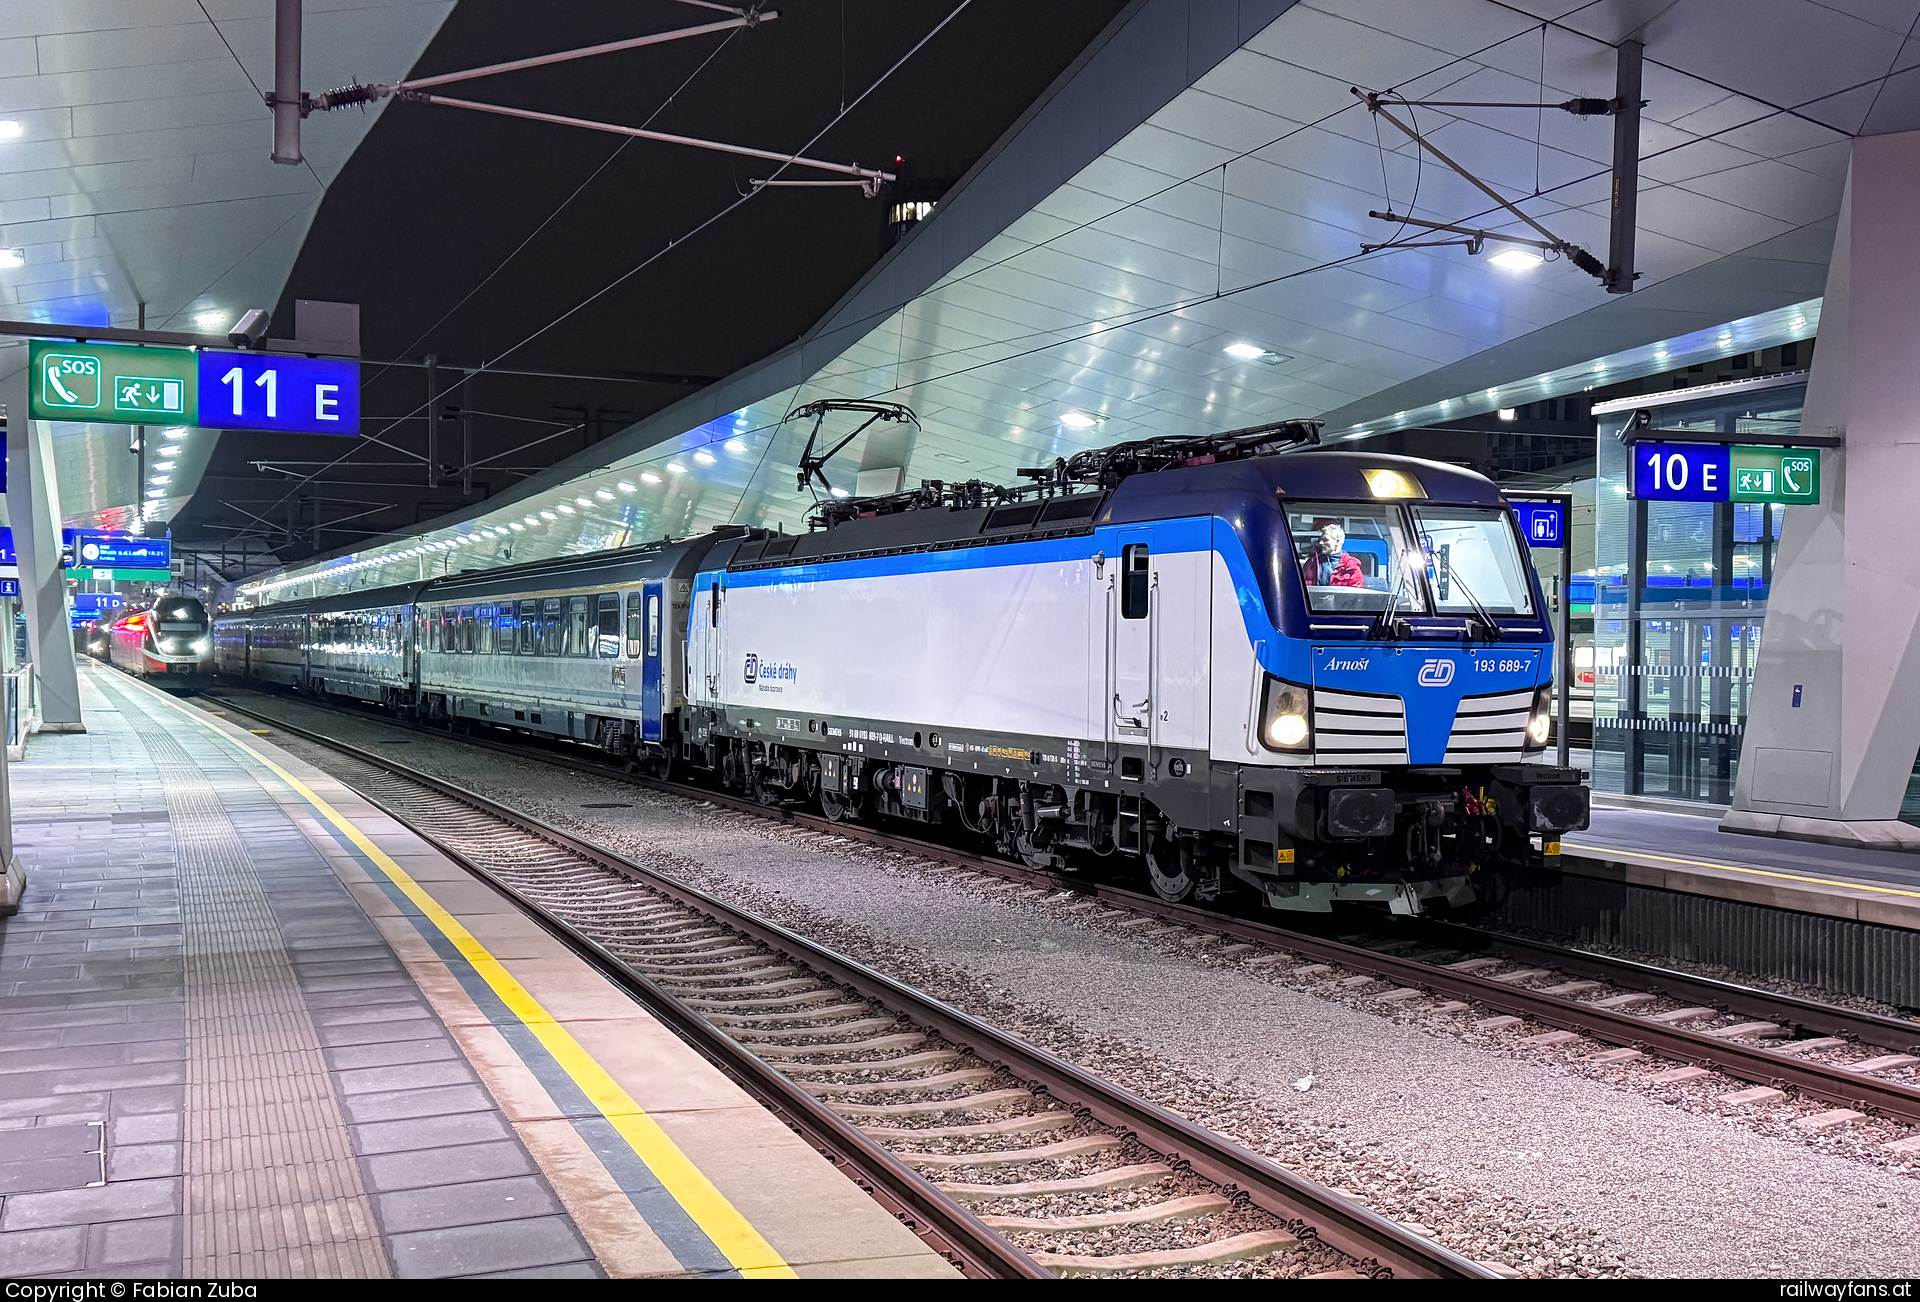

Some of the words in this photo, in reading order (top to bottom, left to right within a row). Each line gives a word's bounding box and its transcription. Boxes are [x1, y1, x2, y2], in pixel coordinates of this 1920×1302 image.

[62, 359, 95, 375] SOS
[221, 367, 277, 418] 11
[315, 384, 339, 421] E
[1647, 453, 1689, 491] 10
[1702, 464, 1718, 491] E
[1791, 460, 1810, 472] SOS
[95, 597, 108, 607] 11
[112, 599, 120, 607] D
[1324, 656, 1370, 671] Arnošt
[1473, 659, 1496, 672] 193
[1499, 659, 1532, 673] 689-7
[759, 659, 777, 679] České
[778, 662, 798, 685] dráhy
[827, 727, 842, 737] SIEMENS
[1336, 774, 1372, 783] SIEMENS
[1535, 772, 1561, 780] Vectron
